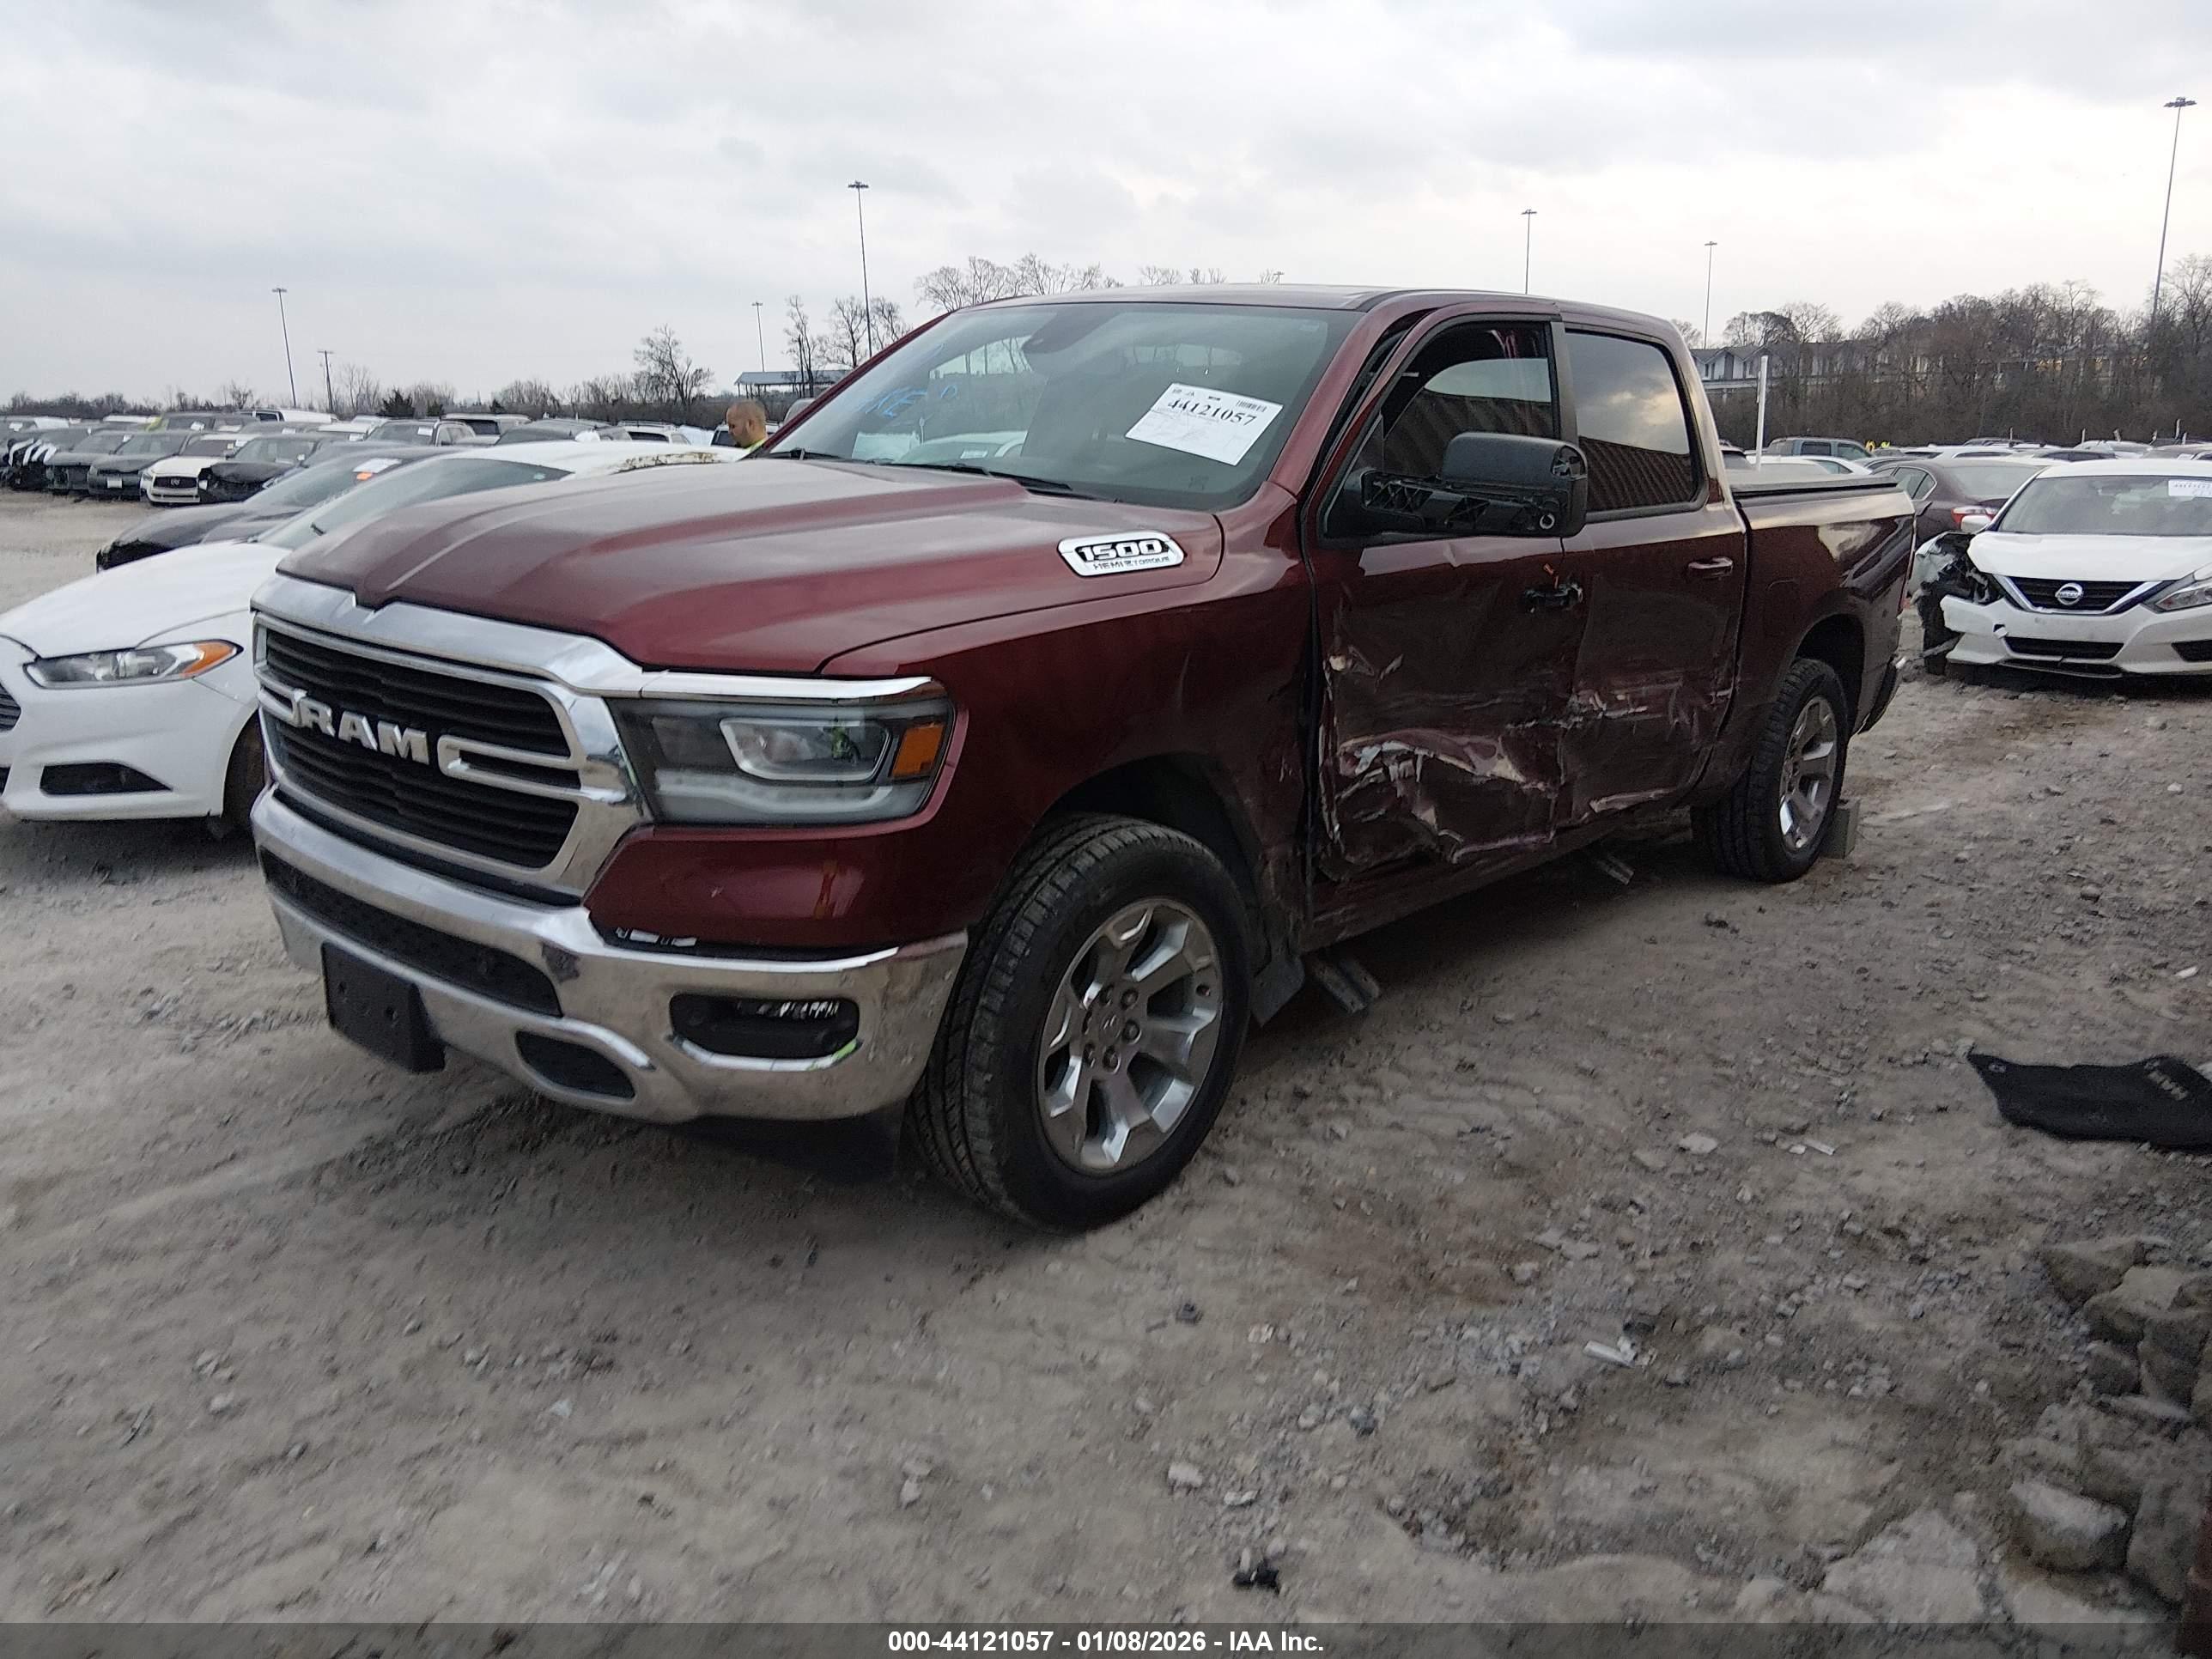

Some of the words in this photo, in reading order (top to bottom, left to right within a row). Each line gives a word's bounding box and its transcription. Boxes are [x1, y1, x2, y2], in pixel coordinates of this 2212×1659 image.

[1168, 398, 1257, 426] 44121057
[1079, 539, 1163, 562] 1500
[300, 697, 429, 764] RAM
